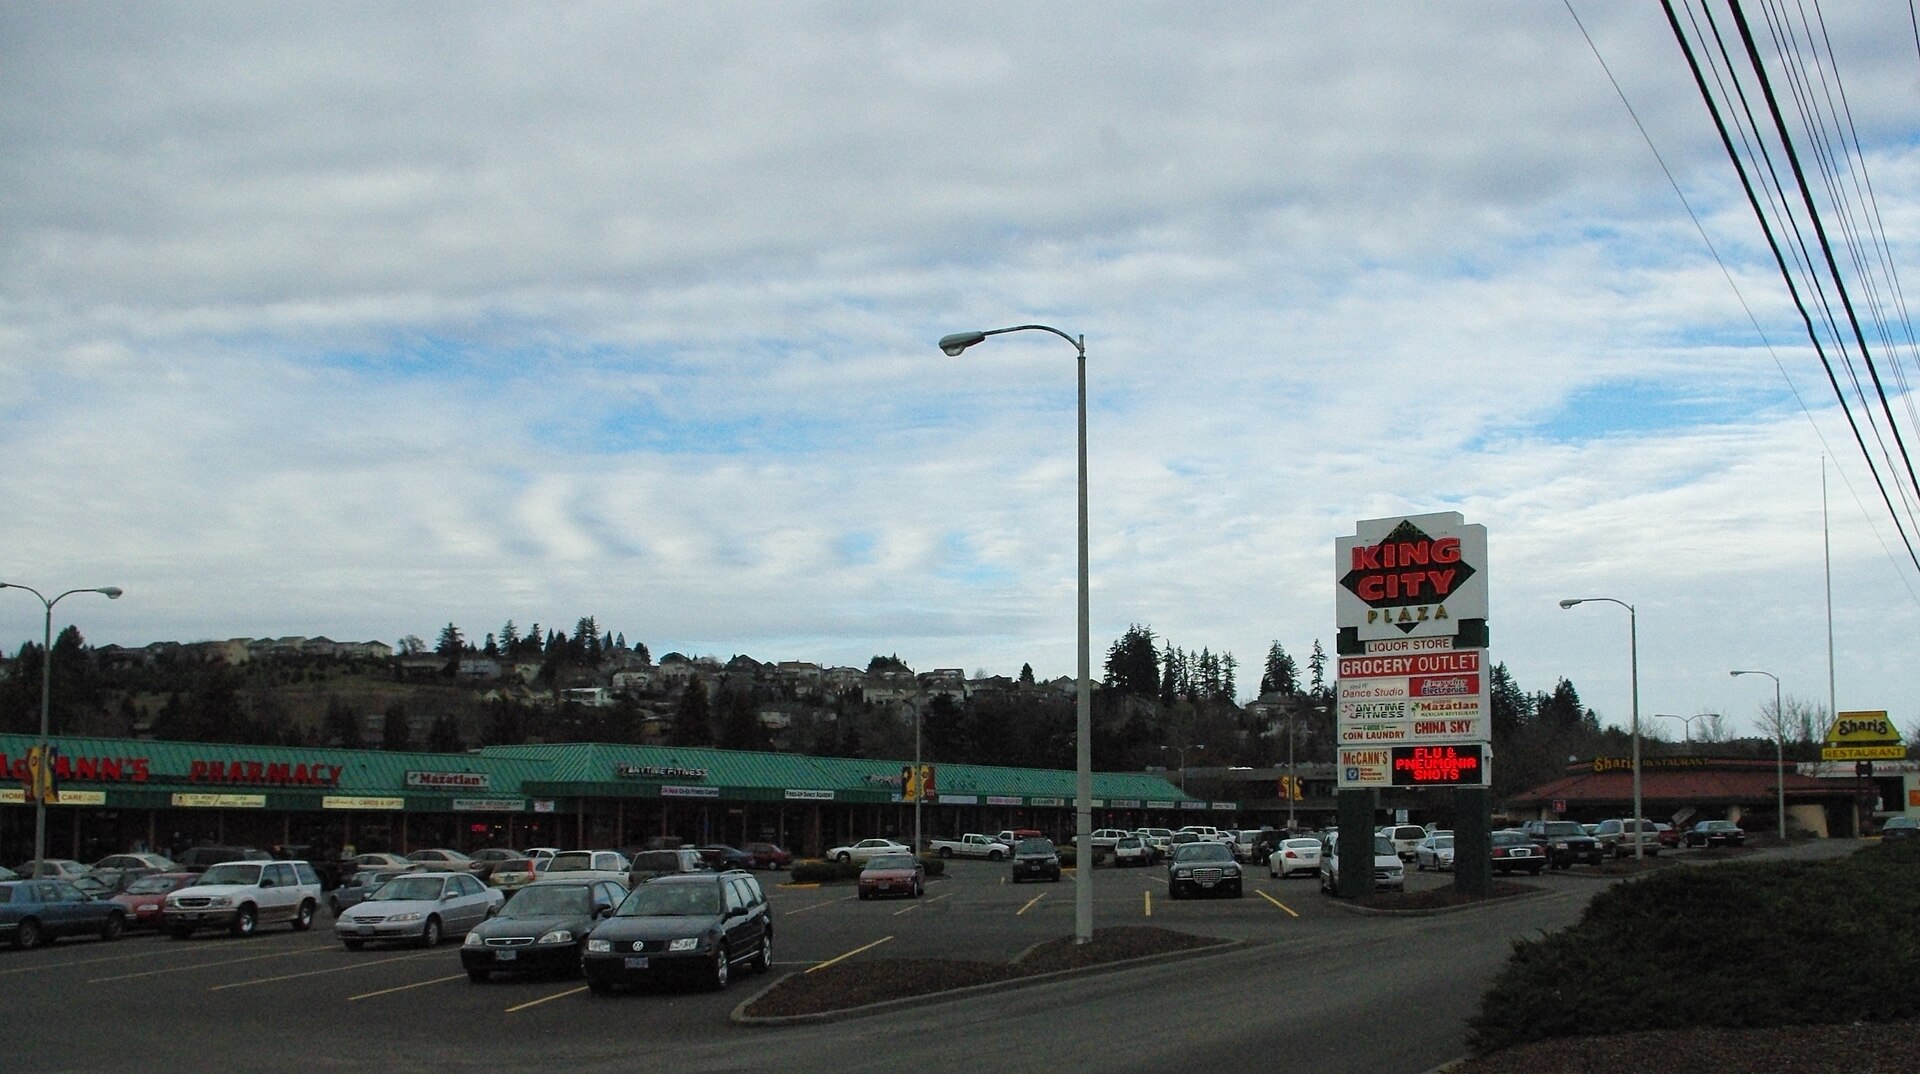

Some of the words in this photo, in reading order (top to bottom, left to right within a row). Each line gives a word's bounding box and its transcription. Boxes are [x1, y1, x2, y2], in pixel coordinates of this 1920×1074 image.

[1352, 537, 1461, 570] KING
[1358, 569, 1455, 600] CITY
[1367, 605, 1448, 624] PLAZA
[1368, 640, 1409, 653] LIQUOR
[1413, 638, 1450, 650] STORE
[1341, 658, 1412, 675] GROCERY
[1418, 654, 1478, 671] OUTLET
[1342, 689, 1371, 698] Dance
[1374, 687, 1404, 697] Studio
[1355, 702, 1405, 712] ANYTIME
[1421, 701, 1478, 711] Mazatlan
[1355, 711, 1404, 719] FITNESS
[1414, 722, 1447, 735] CHINA
[1450, 720, 1471, 733] SKY
[1342, 732, 1363, 740] COIN
[1366, 730, 1405, 739] LAUNDRY
[1343, 752, 1388, 765] McCANN'S
[1414, 748, 1442, 759] FLU
[1448, 747, 1456, 758] &
[1824, 748, 1901, 758] RESTAURANT
[1396, 758, 1477, 770] PNEUMONIA
[189, 760, 343, 785] PHARMACY
[628, 766, 666, 775] ANYTIME
[667, 767, 708, 776] FITNESS
[1414, 769, 1459, 780] SHOTS
[420, 773, 480, 785] Mazatlan
[61, 793, 82, 801] CARE
